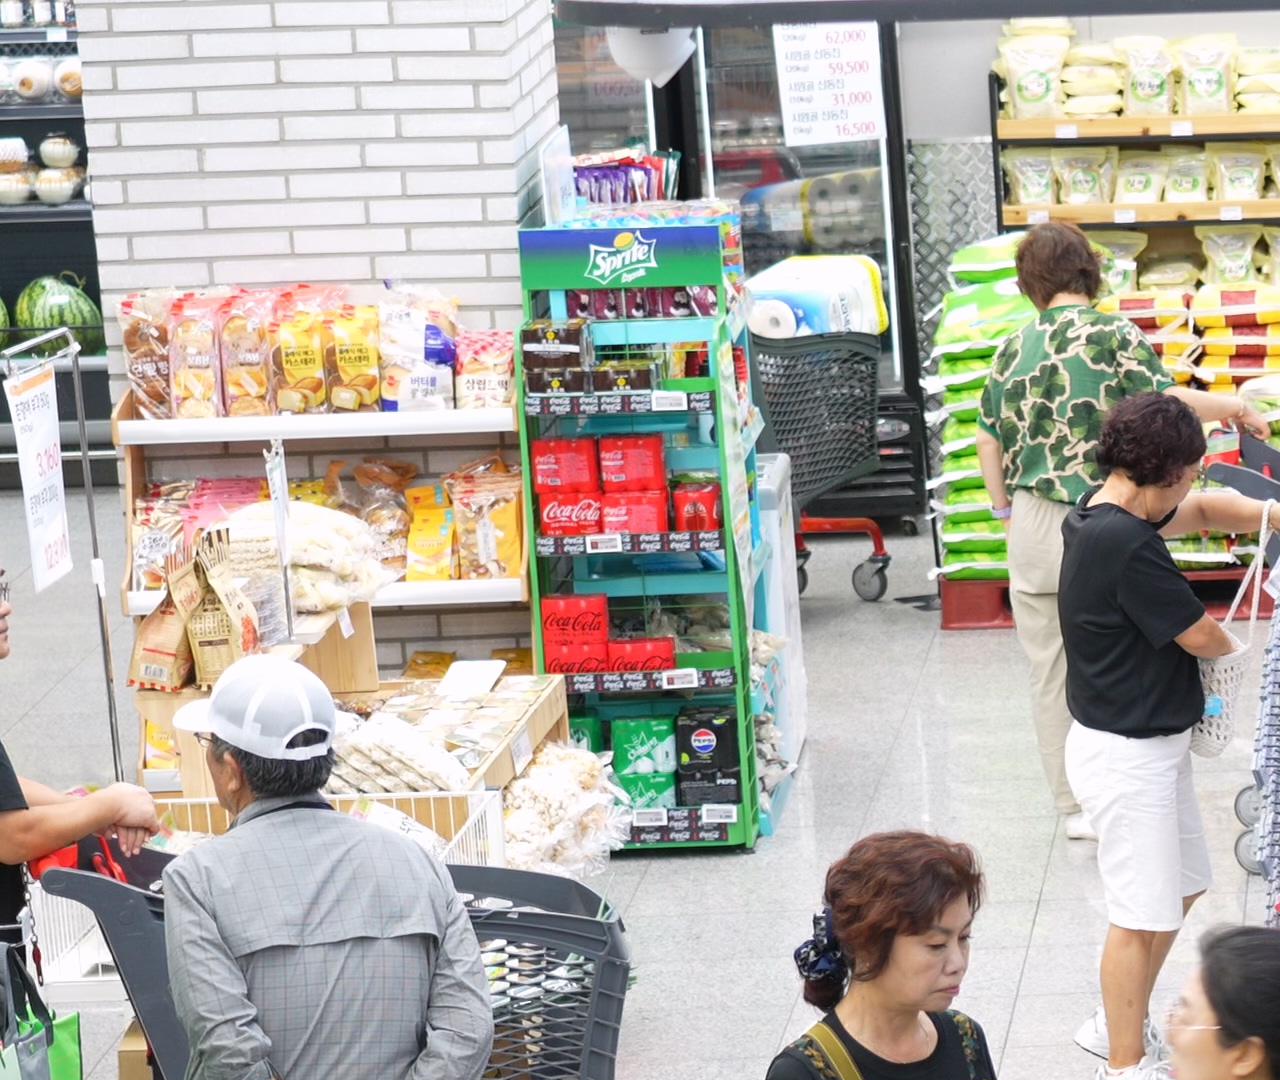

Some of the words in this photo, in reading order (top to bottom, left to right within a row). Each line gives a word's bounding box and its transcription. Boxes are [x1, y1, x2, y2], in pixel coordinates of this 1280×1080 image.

[825, 29, 866, 44] 62,000
[828, 60, 870, 76] 59,500
[831, 91, 873, 106] 31,000
[835, 120, 876, 137] 16,500
[593, 242, 649, 278] Sprite
[542, 499, 601, 523] Coca-Cola
[544, 611, 602, 631] Coca-Cola
